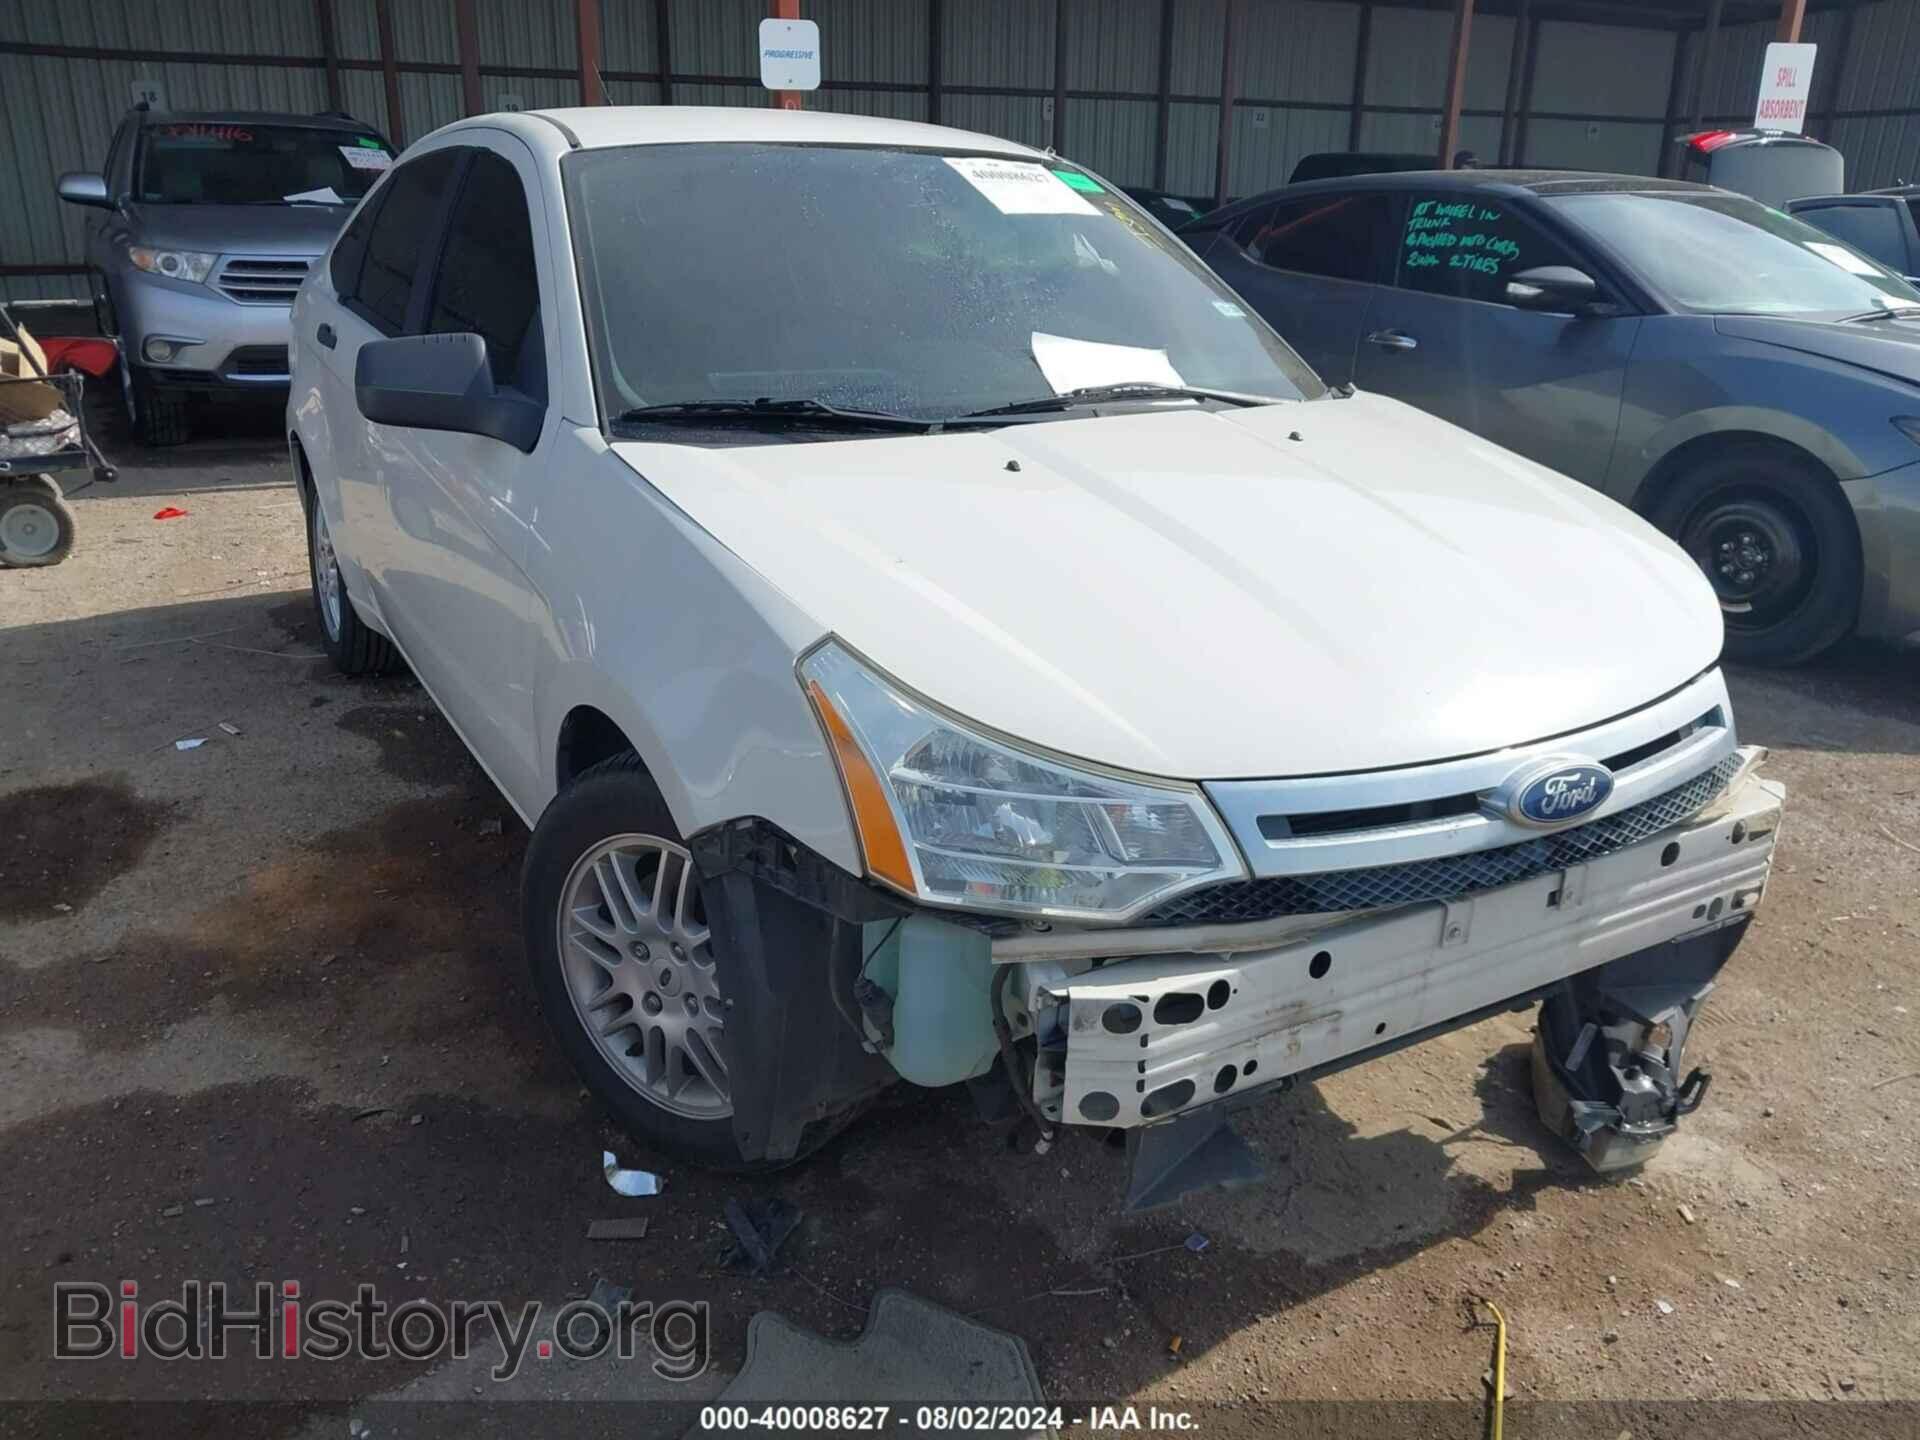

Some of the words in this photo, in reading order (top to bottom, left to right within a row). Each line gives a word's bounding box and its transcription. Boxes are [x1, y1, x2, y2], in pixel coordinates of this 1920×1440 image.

[764, 49, 815, 60] PROGRESSIVE
[1776, 66, 1798, 88] SPILL
[1759, 98, 1805, 120] ABSORBENT
[1542, 773, 1597, 814] Ford
